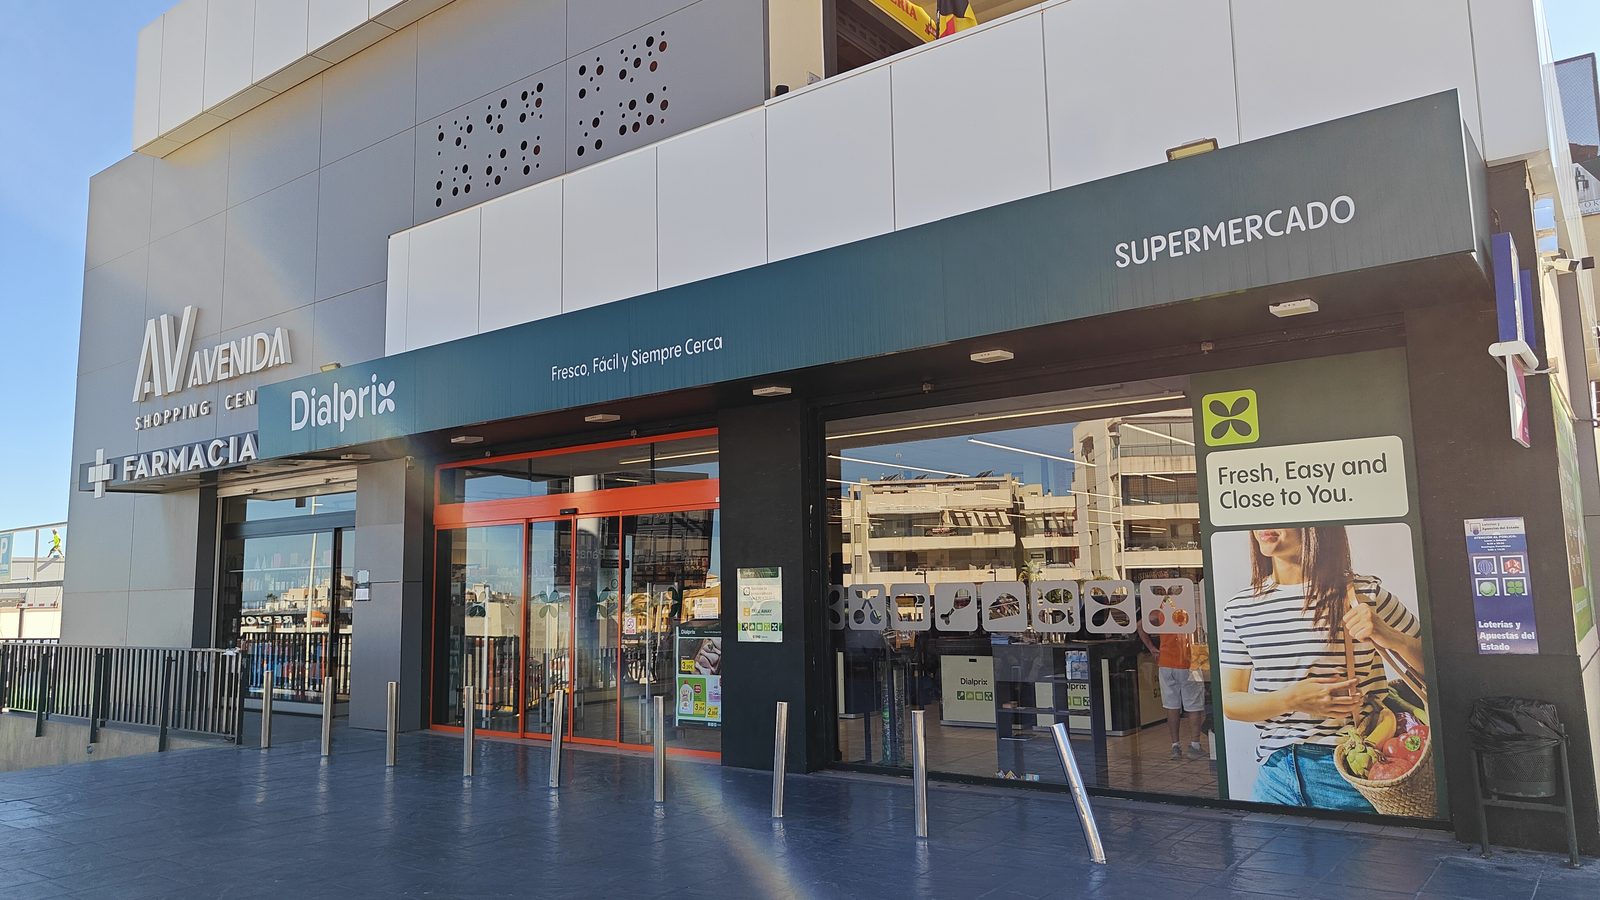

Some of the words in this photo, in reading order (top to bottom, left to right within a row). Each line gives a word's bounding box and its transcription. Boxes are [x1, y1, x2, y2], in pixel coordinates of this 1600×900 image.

[1115, 195, 1356, 268] SUPERMERCADO
[132, 305, 199, 402] AV
[187, 327, 293, 389] AVENIDA
[551, 363, 590, 381] Fresco,
[593, 352, 619, 373] Fácil
[621, 354, 629, 372] y
[631, 343, 682, 366] Siempre
[685, 336, 723, 355] Cerca
[134, 400, 210, 431] SHOPPING
[291, 373, 396, 433] Dialprix
[122, 433, 258, 481] FARMACIA
[1218, 462, 1279, 486] Fresh,
[1285, 460, 1336, 483] Easy
[1341, 452, 1387, 476] and
[1219, 489, 1275, 509] Close
[1279, 487, 1301, 506] to
[1306, 484, 1353, 504] You.
[1480, 631, 1519, 641] Apuestas
[1521, 631, 1535, 640] del
[1480, 642, 1510, 651] Estado
[960, 677, 988, 686] Dialprix
